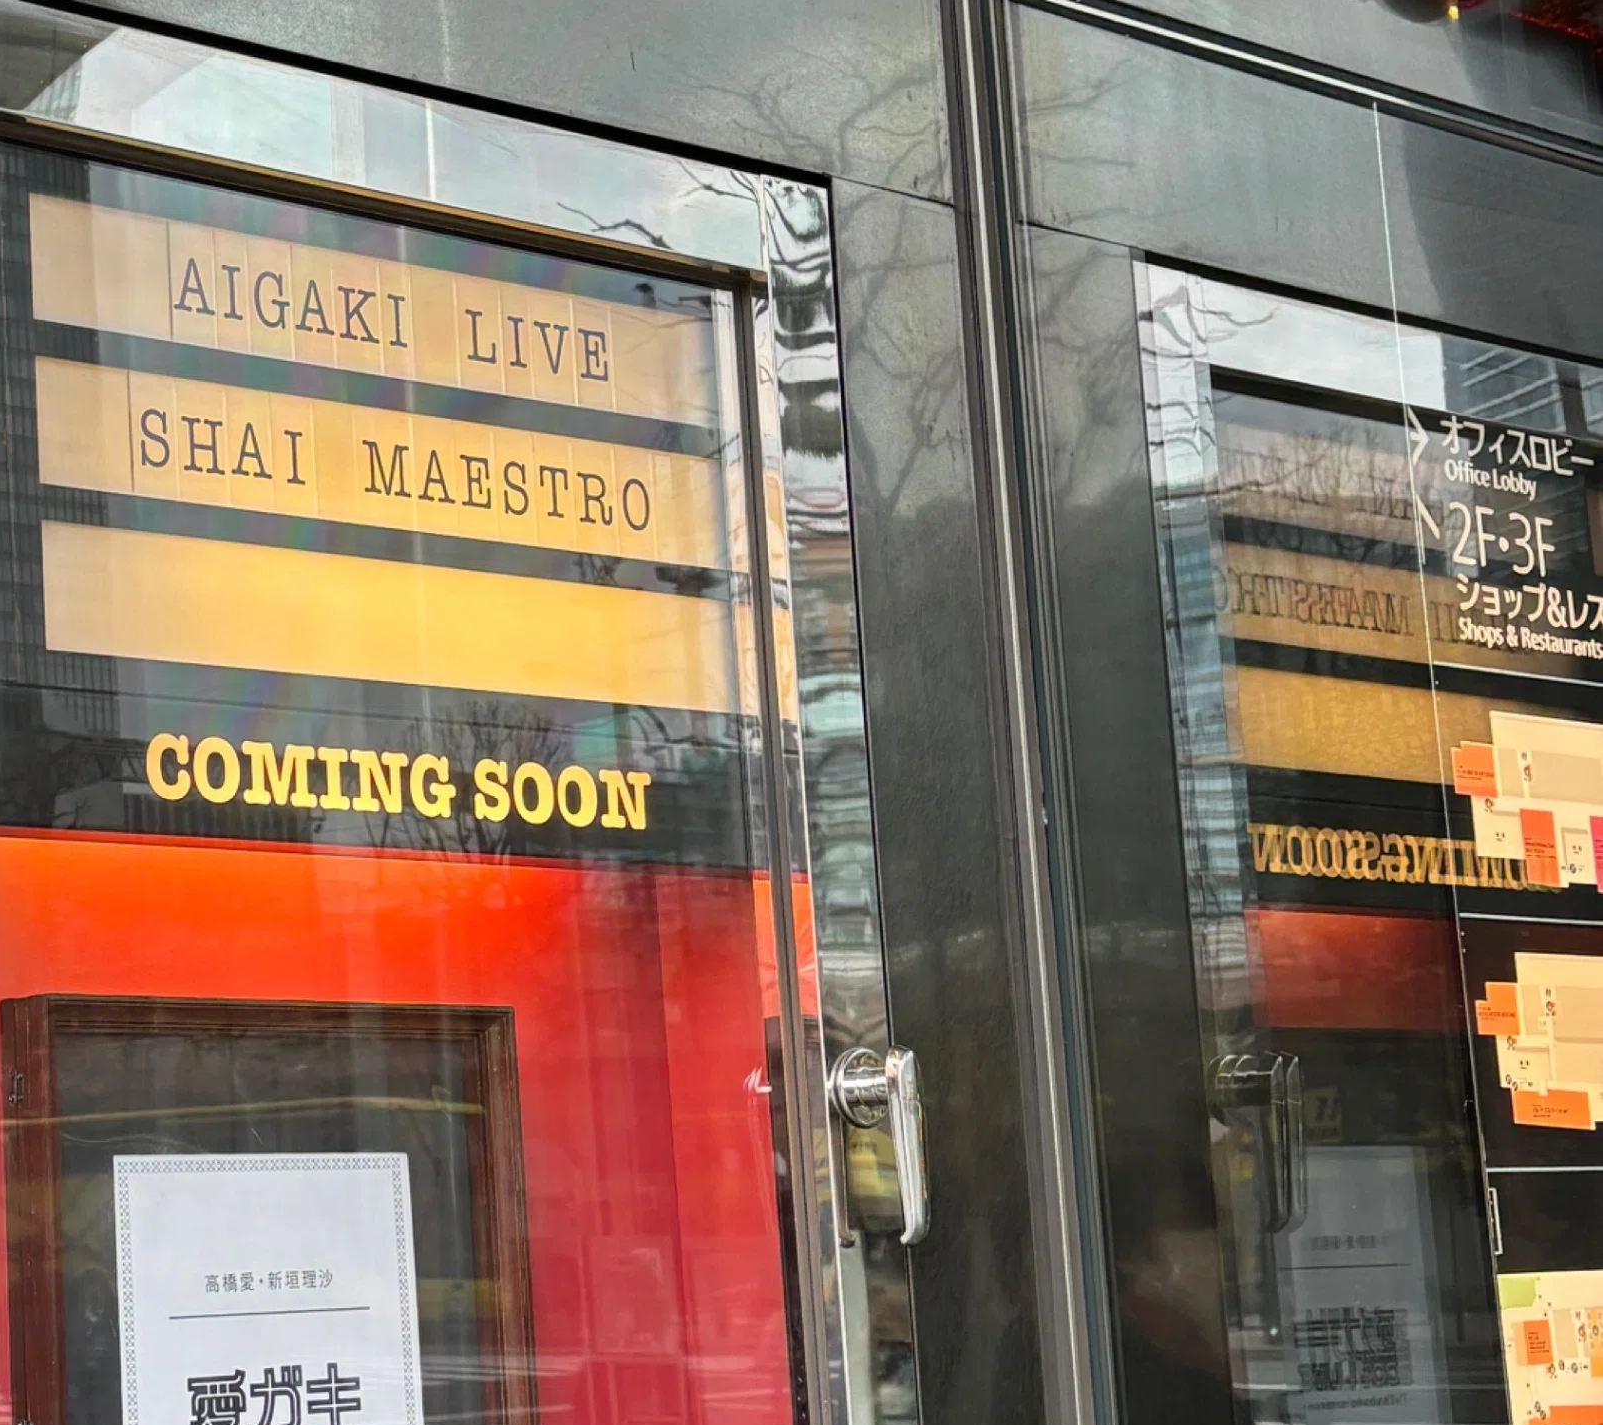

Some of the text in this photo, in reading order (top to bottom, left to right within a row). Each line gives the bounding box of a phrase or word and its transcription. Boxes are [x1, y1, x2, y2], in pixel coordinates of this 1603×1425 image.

[172, 257, 611, 382] AIGAKI LIVE
[139, 407, 652, 533] SHAI MAESTRO
[1440, 414, 1595, 477] オフィスロビー
[1444, 459, 1490, 488] Office
[1493, 470, 1537, 501] Lobby
[1458, 616, 1504, 650] Shops
[1507, 623, 1518, 648] &
[1520, 626, 1603, 661] Restaurants
[146, 733, 653, 832] COMING SOON
